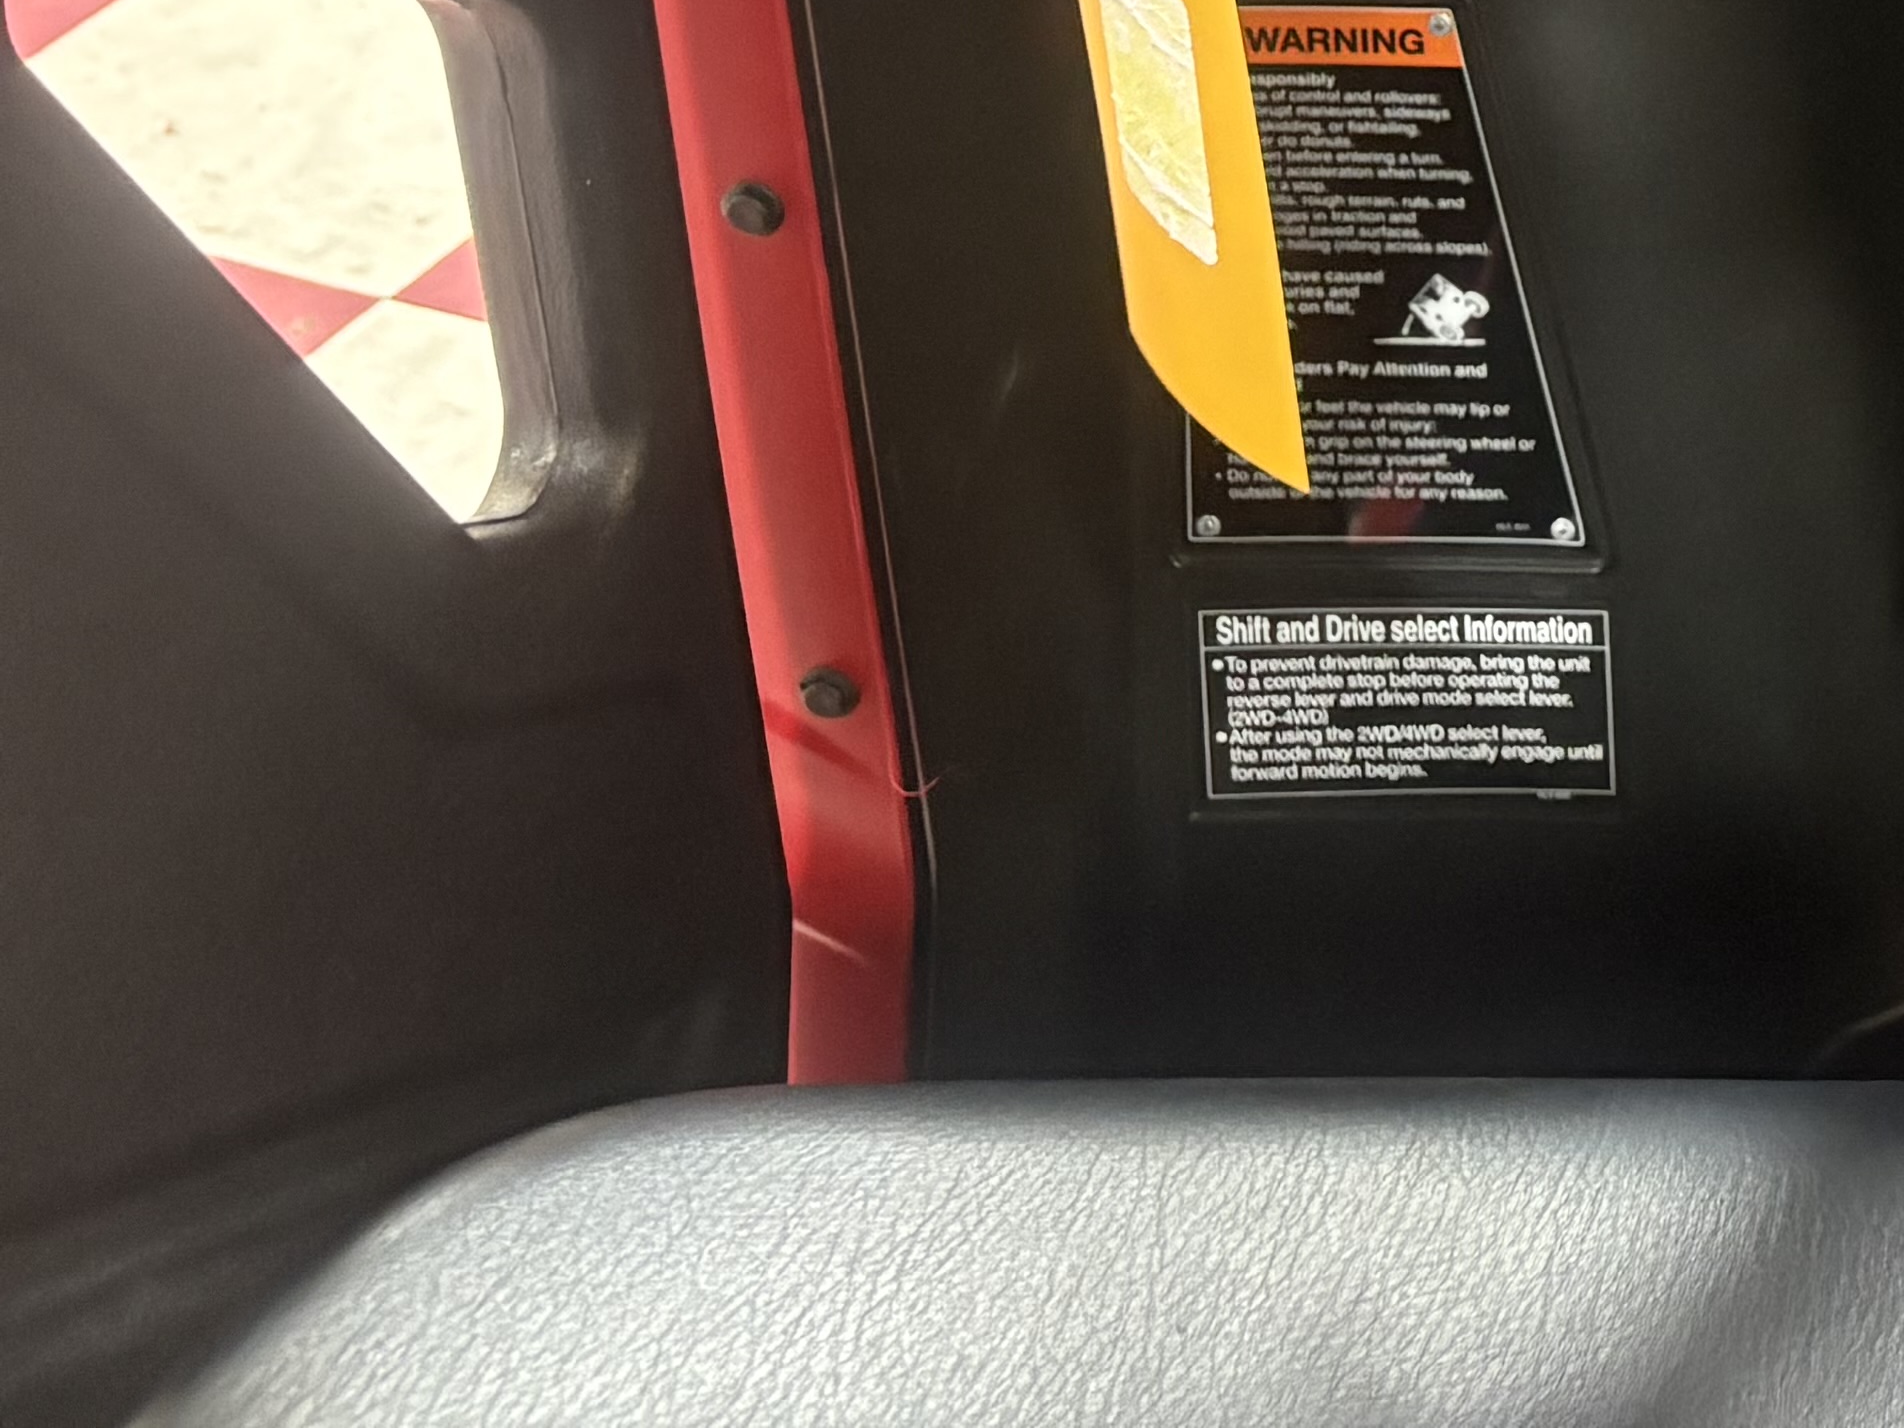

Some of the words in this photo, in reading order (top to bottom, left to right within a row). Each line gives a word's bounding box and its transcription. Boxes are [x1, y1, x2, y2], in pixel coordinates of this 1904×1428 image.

[1244, 26, 1426, 56] WARNING
[1283, 270, 1320, 284] have
[1323, 270, 1384, 285] caused
[1294, 361, 1333, 376] ders
[1337, 361, 1370, 380] Pay
[1373, 361, 1451, 378] Attention
[1454, 362, 1488, 379] and
[1215, 614, 1272, 645] Shift
[1276, 614, 1320, 643] and
[1325, 614, 1386, 643] Drive
[1390, 614, 1460, 643] select
[1464, 614, 1593, 644] Information
[1224, 655, 1248, 673] To
[1250, 655, 1316, 675] prevent
[1319, 653, 1400, 671] drivetrain
[1402, 653, 1477, 673] damage,
[1479, 653, 1525, 674] bring
[1527, 654, 1556, 672] the
[1557, 655, 1591, 673] unit
[1225, 675, 1245, 692] to
[1247, 677, 1261, 691] a
[1263, 673, 1344, 691] complete
[1346, 673, 1387, 691] stop
[1389, 671, 1445, 689] before
[1447, 672, 1530, 690] operating
[1531, 673, 1560, 689] the
[1226, 694, 1292, 709] reverse
[1294, 691, 1338, 708] lever
[1339, 690, 1374, 708] and
[1376, 690, 1420, 707] drive
[1422, 690, 1473, 707] mode
[1475, 690, 1526, 707] select
[1529, 690, 1574, 708] lever.
[1229, 728, 1273, 745] After
[1275, 727, 1323, 746] using
[1325, 726, 1355, 742] the
[1357, 724, 1445, 743] 2WD/4WD
[1447, 724, 1499, 742] select
[1501, 724, 1547, 744] lever,
[1229, 746, 1259, 764] the
[1261, 746, 1313, 762] mode
[1315, 747, 1353, 764] may
[1355, 745, 1385, 761] not
[1387, 743, 1499, 764] mechanically
[1500, 745, 1565, 764] engage
[1567, 743, 1604, 761] until
[1230, 763, 1299, 782] forward
[1301, 762, 1362, 780] motion
[1364, 761, 1429, 781] begins.
